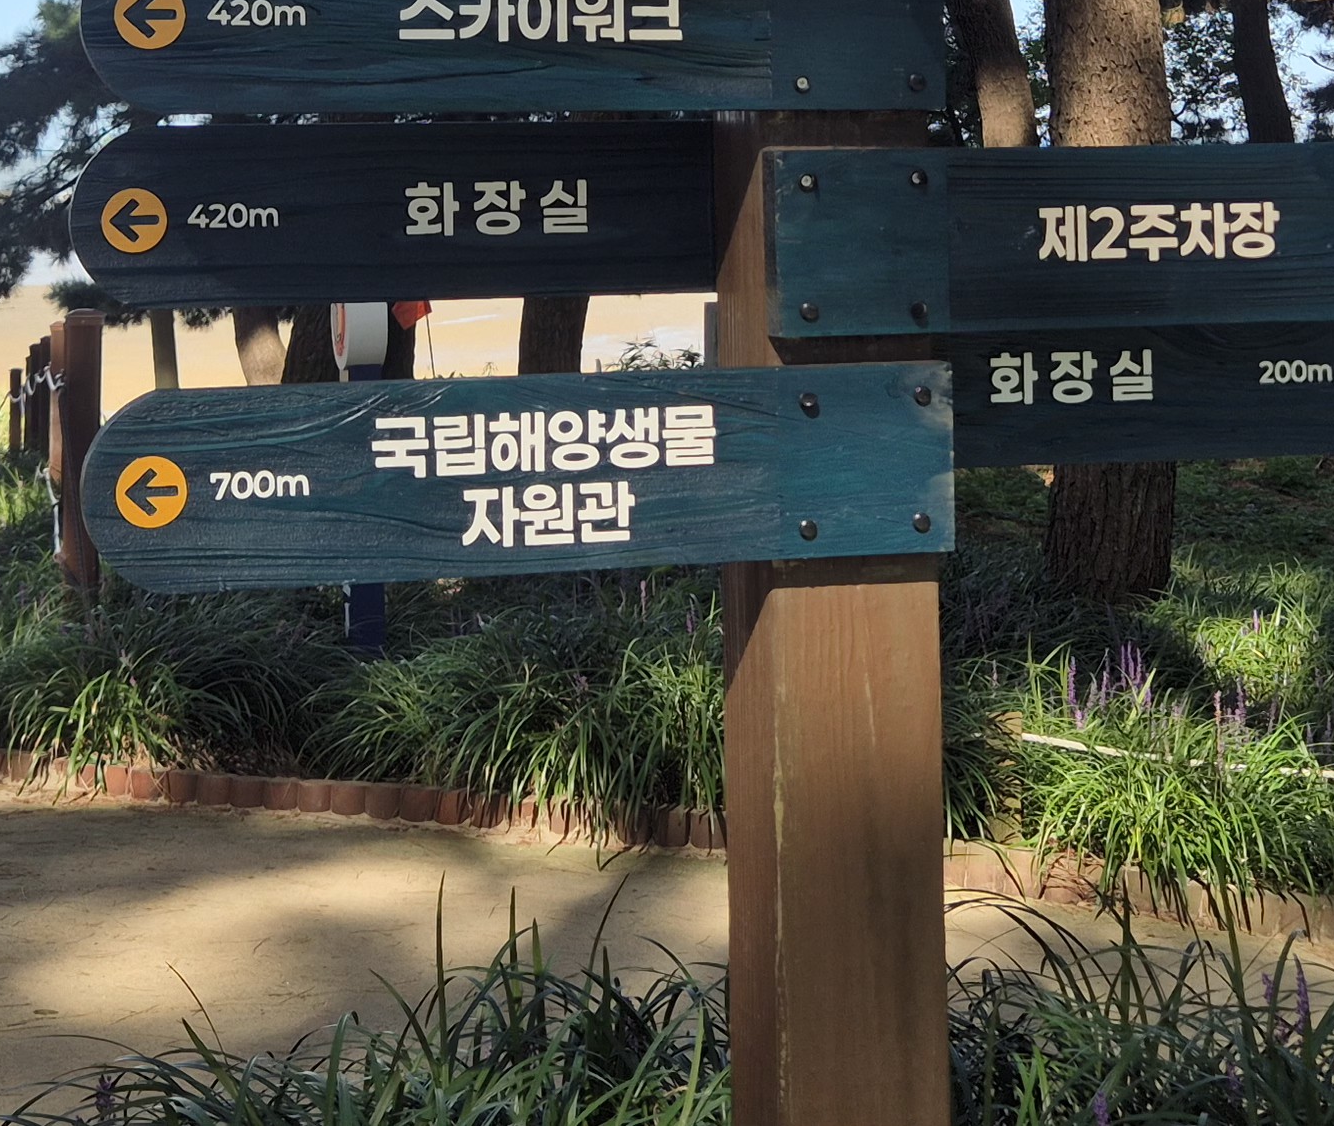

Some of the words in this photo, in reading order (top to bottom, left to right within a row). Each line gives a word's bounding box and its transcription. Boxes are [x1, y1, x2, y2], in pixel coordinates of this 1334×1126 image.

[186, 202, 280, 229] 420m
[403, 178, 590, 237] 화장실
[1038, 200, 1281, 262] 제2주차장
[989, 348, 1154, 406] 화장실
[1258, 359, 1334, 385] 200m
[371, 404, 717, 478] 국립해양생물
[209, 470, 311, 502] 700m
[462, 481, 636, 548] 자원관
